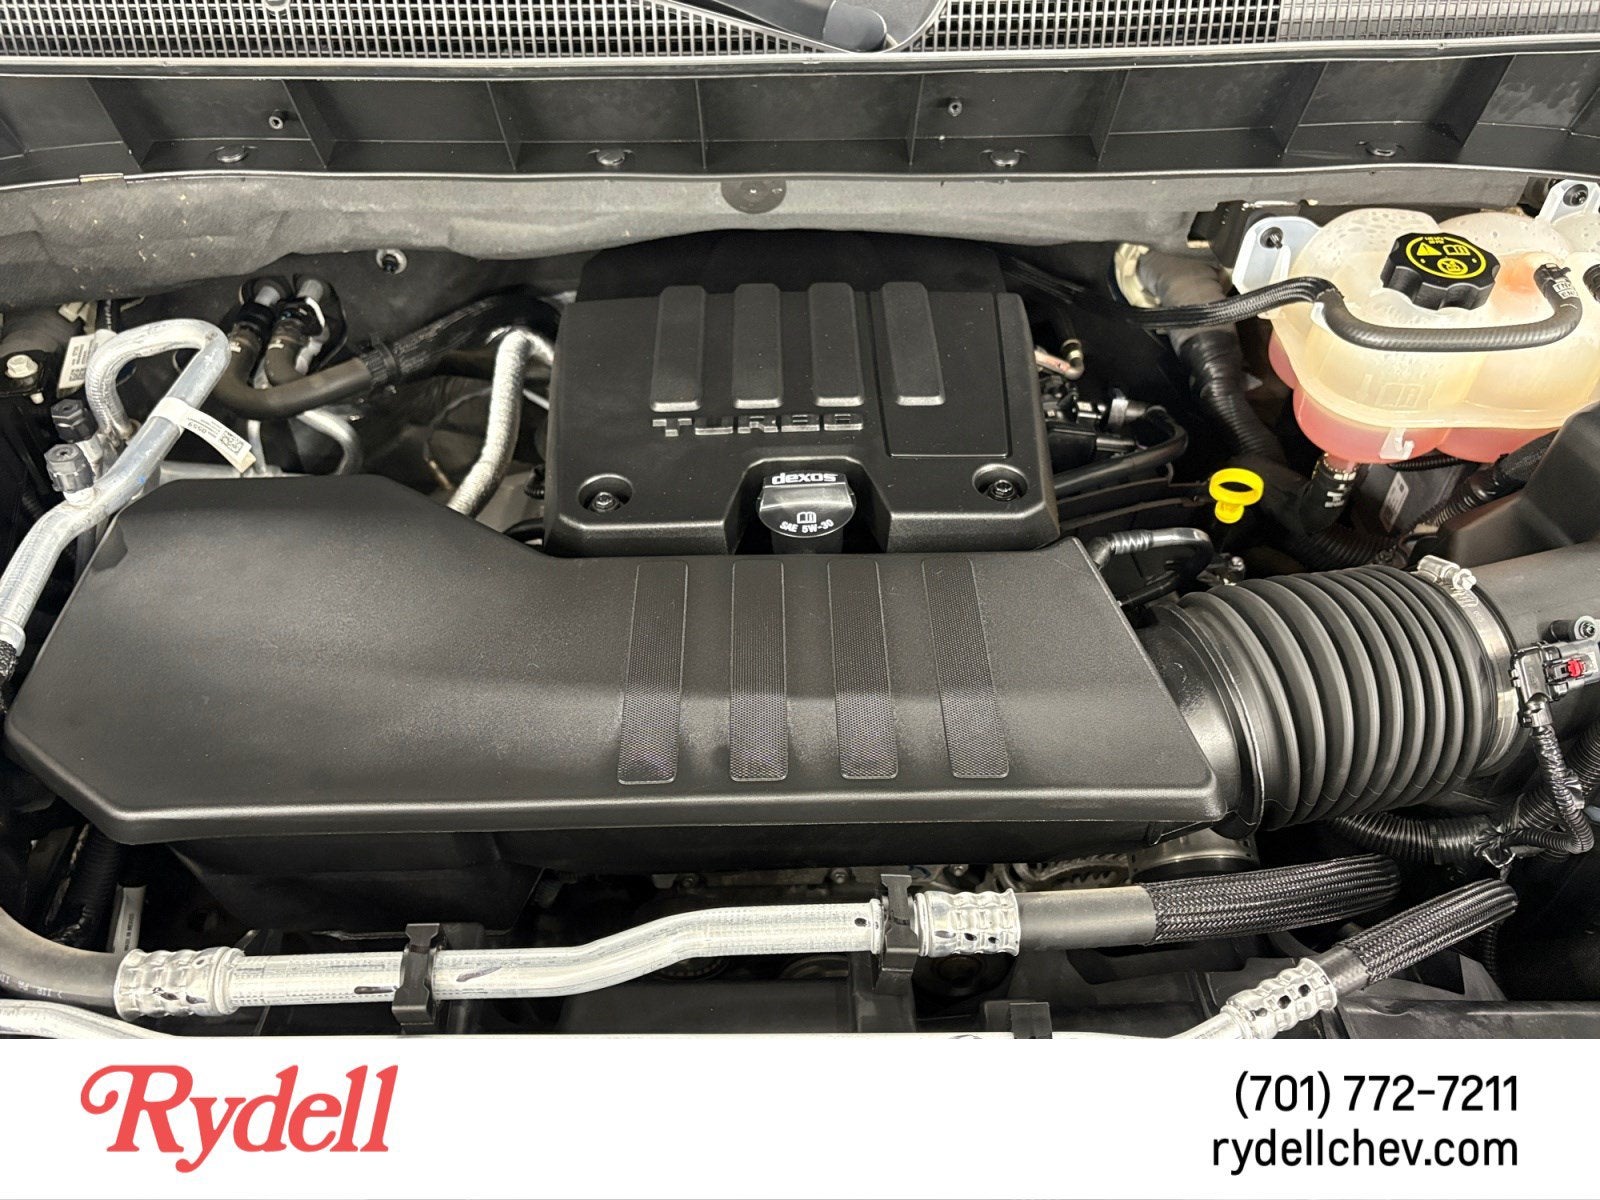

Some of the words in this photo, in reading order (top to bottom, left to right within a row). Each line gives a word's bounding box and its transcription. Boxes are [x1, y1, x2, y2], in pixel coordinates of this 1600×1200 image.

[652, 413, 863, 437] TURBO
[771, 472, 838, 485] dexos
[779, 521, 798, 533] SAE
[801, 519, 834, 533] 5W-30
